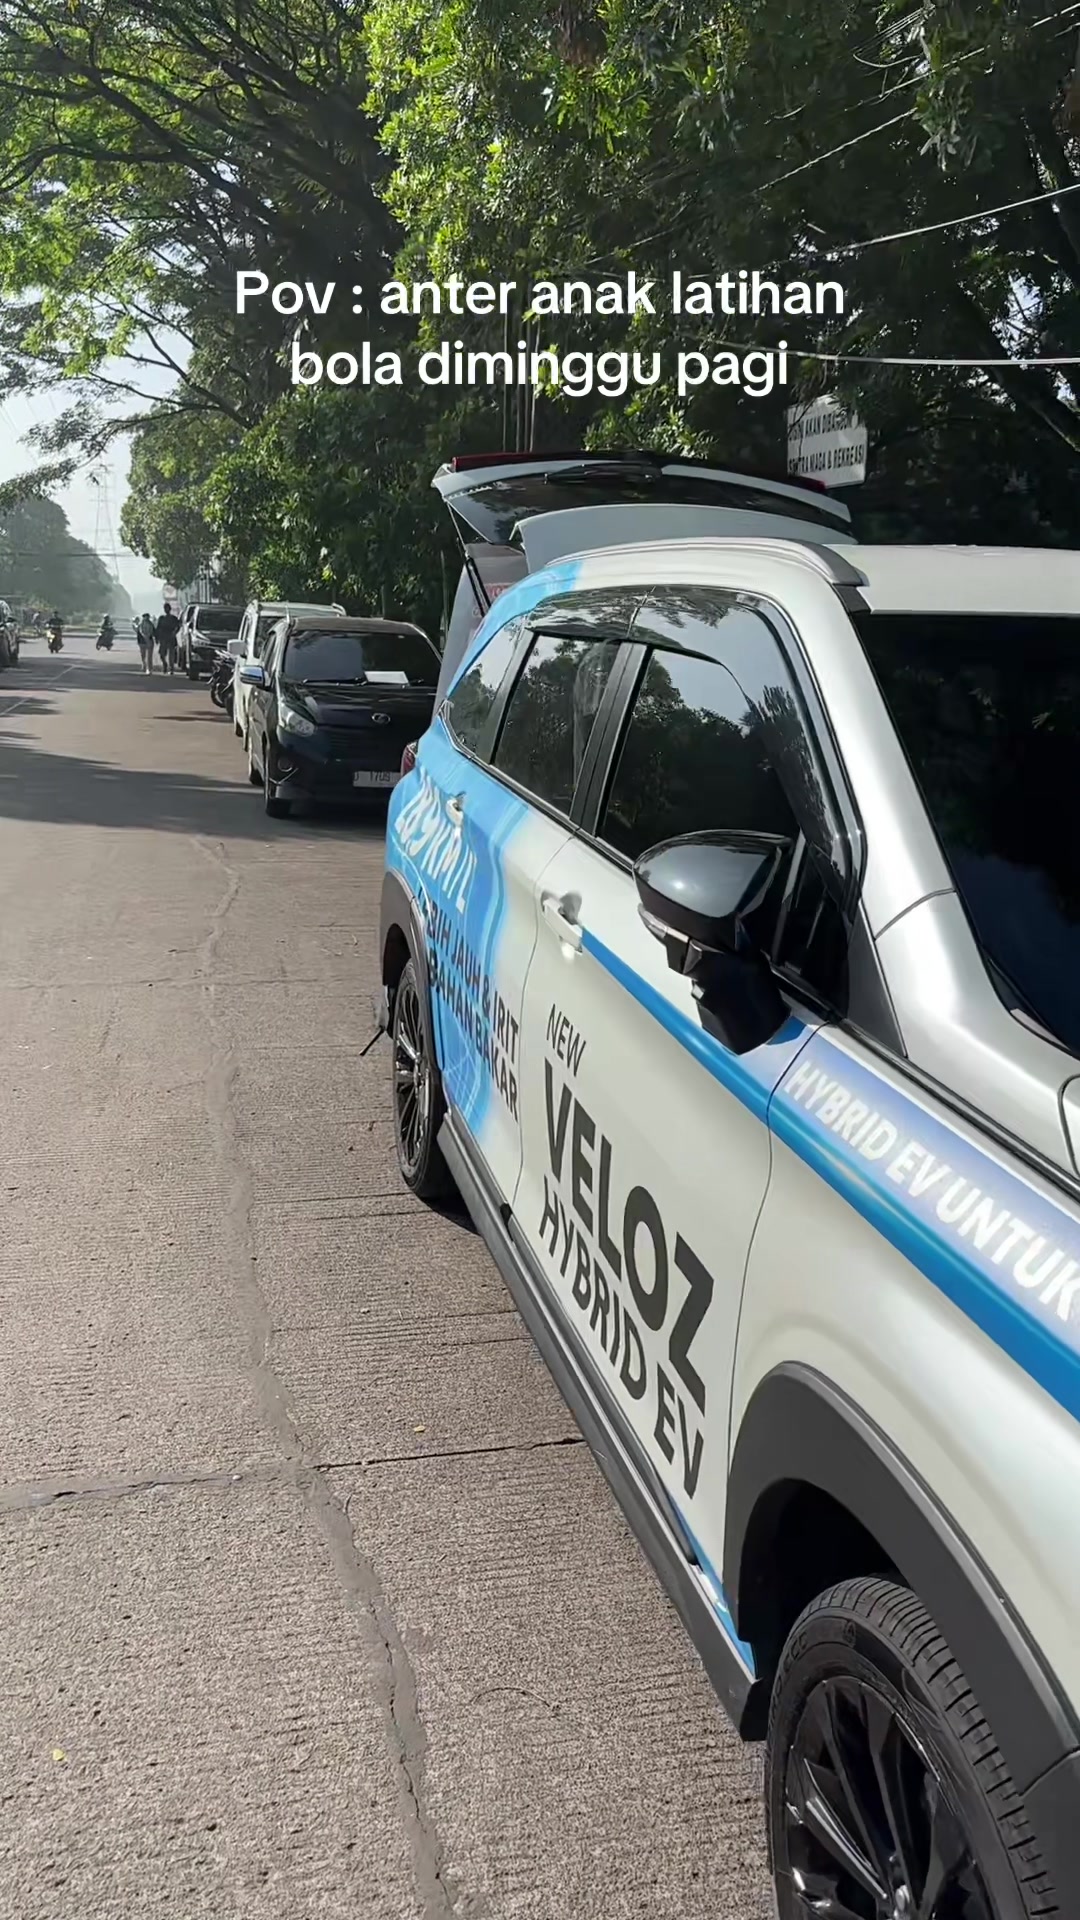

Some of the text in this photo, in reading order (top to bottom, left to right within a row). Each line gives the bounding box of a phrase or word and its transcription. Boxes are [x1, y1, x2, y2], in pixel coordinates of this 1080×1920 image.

[833, 444, 865, 469] REKREASI
[427, 946, 519, 1124] BAHAN BAKAR
[451, 927, 482, 989] JAUH
[481, 973, 491, 1018] &
[492, 989, 519, 1064] IRIT
[547, 1003, 587, 1078] NEW
[544, 1056, 715, 1418] VELOZ
[784, 1060, 1080, 1322] HYBRID EV UNTUK
[538, 1174, 704, 1501] HYBRID EV
